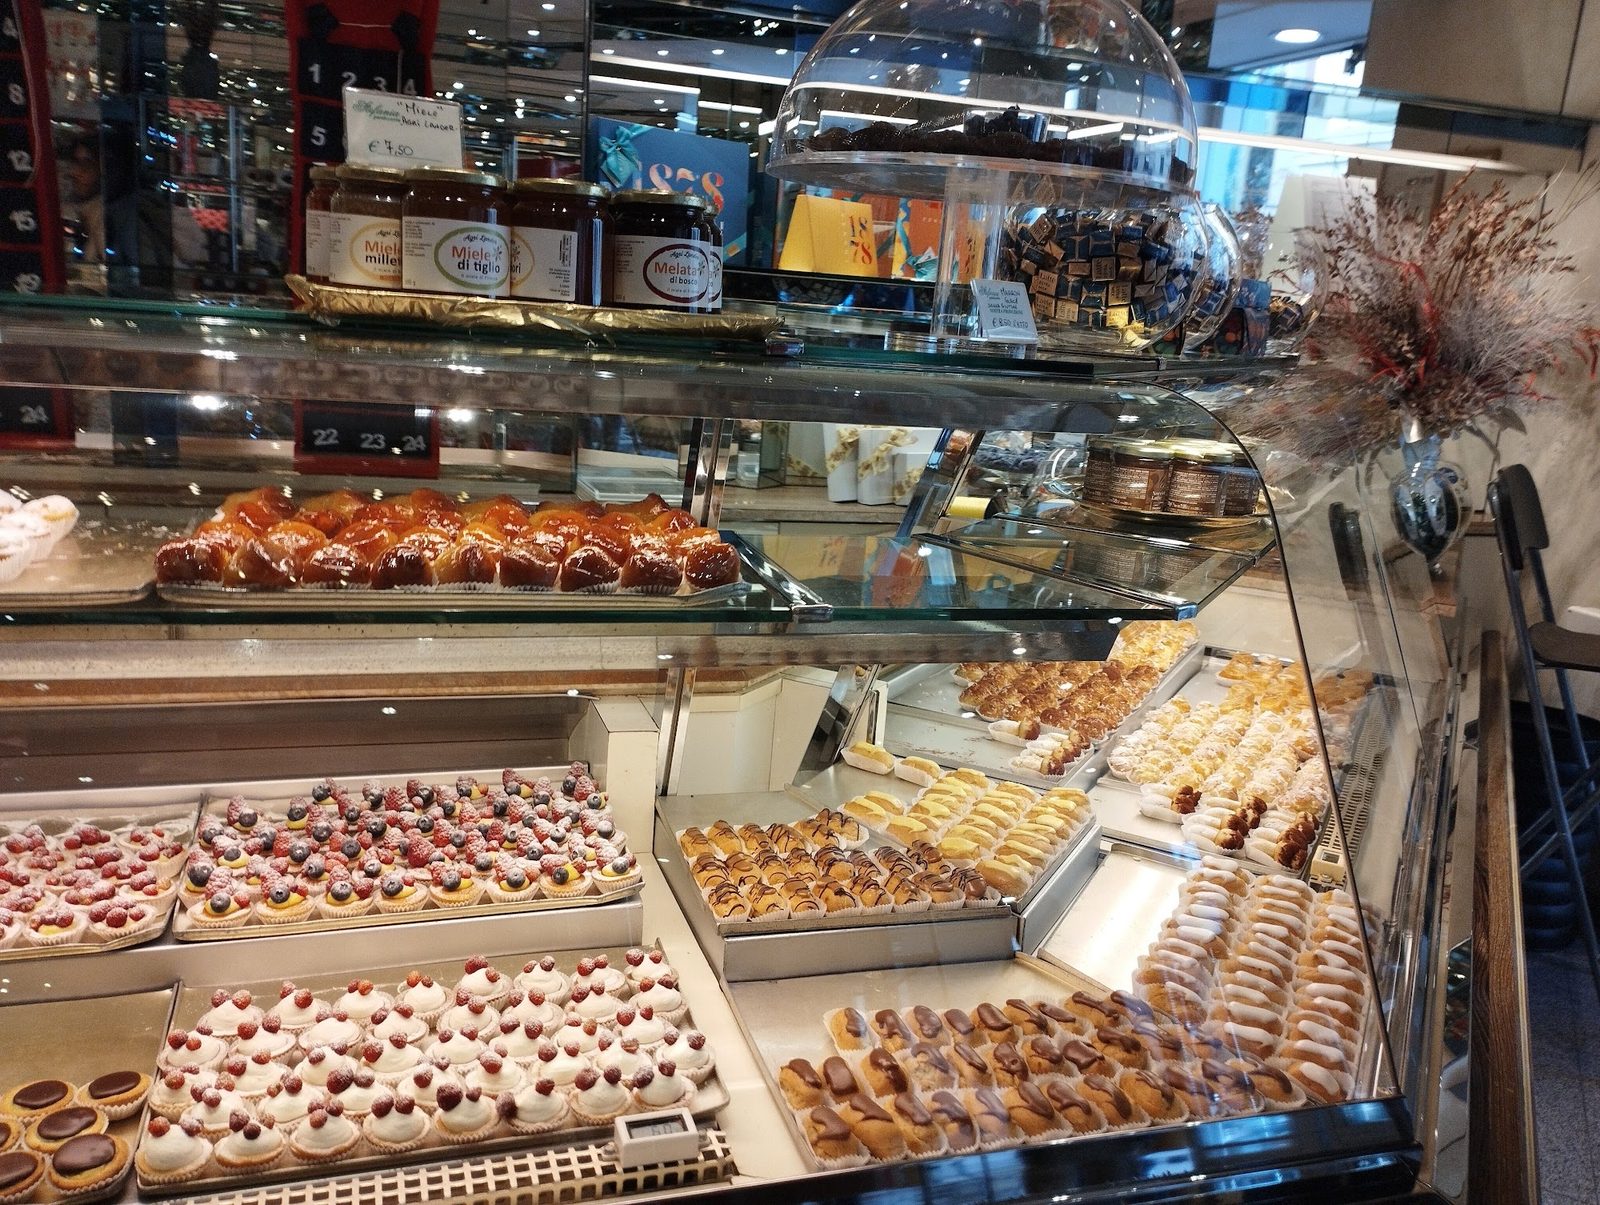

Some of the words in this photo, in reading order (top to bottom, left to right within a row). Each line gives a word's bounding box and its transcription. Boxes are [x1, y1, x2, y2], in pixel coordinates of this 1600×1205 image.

[308, 63, 321, 84] 1
[341, 71, 358, 88] 2
[373, 76, 388, 91] 3
[403, 79, 417, 95] 4
[8, 83, 25, 105] 8
[310, 125, 327, 146] 5
[368, 140, 380, 153] €
[384, 139, 414, 157] 7,50
[849, 215, 869, 240] 18
[365, 240, 401, 255] Miel
[452, 246, 491, 261] Miele
[850, 239, 873, 265] 78
[457, 259, 469, 270] di
[474, 261, 500, 274] tiglio
[654, 262, 697, 276] Melata
[669, 276, 677, 284] di
[679, 277, 698, 285] bosco
[19, 405, 49, 423] 24
[312, 428, 339, 446] 22
[360, 433, 386, 449] 23
[401, 435, 427, 451] 24
